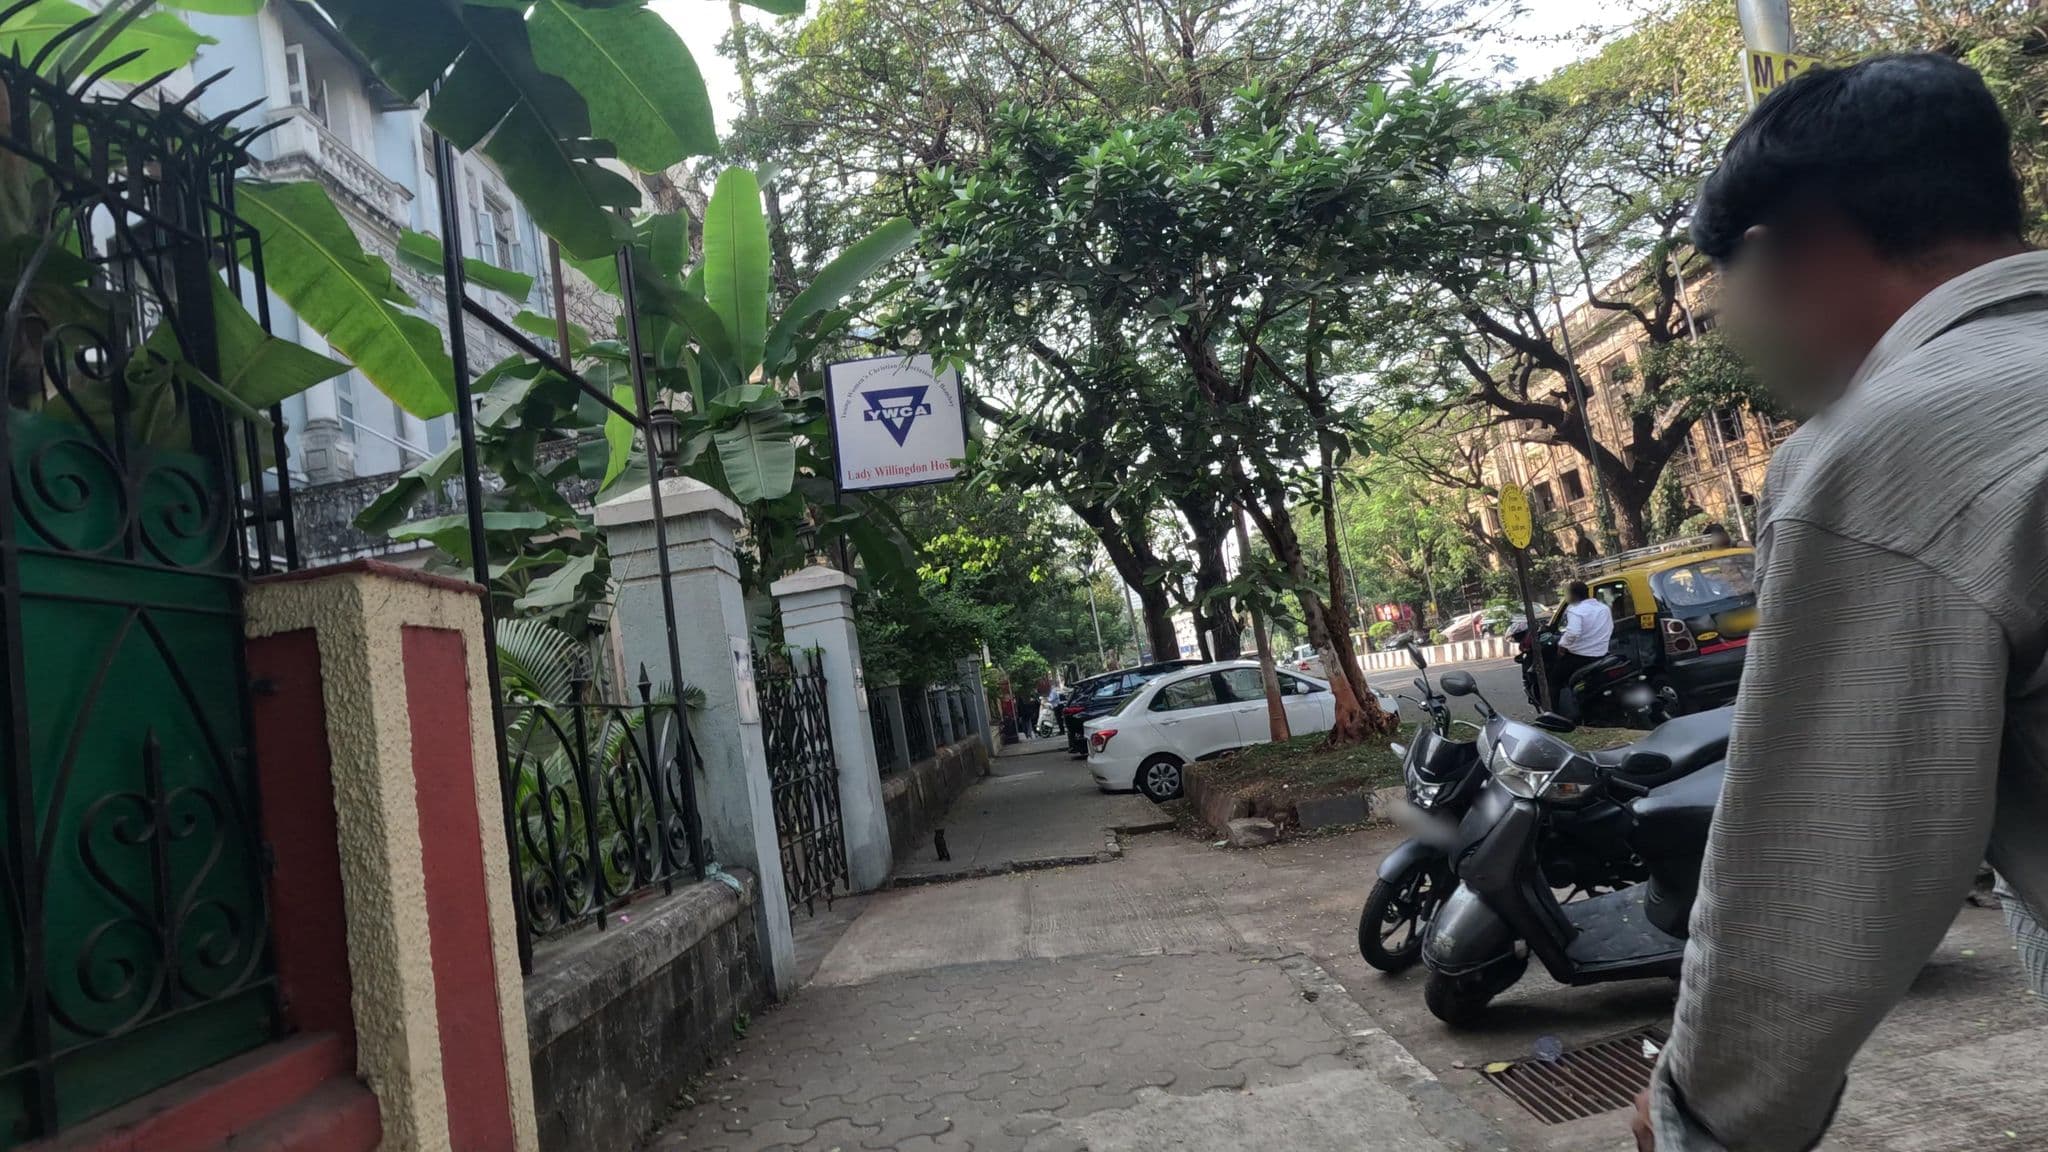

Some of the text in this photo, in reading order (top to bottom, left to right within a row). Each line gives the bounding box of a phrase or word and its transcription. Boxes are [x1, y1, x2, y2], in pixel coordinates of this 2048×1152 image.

[868, 363, 898, 377] Christian
[867, 404, 928, 420] YWCA
[847, 459, 951, 481] Lady Willingdon Hos
